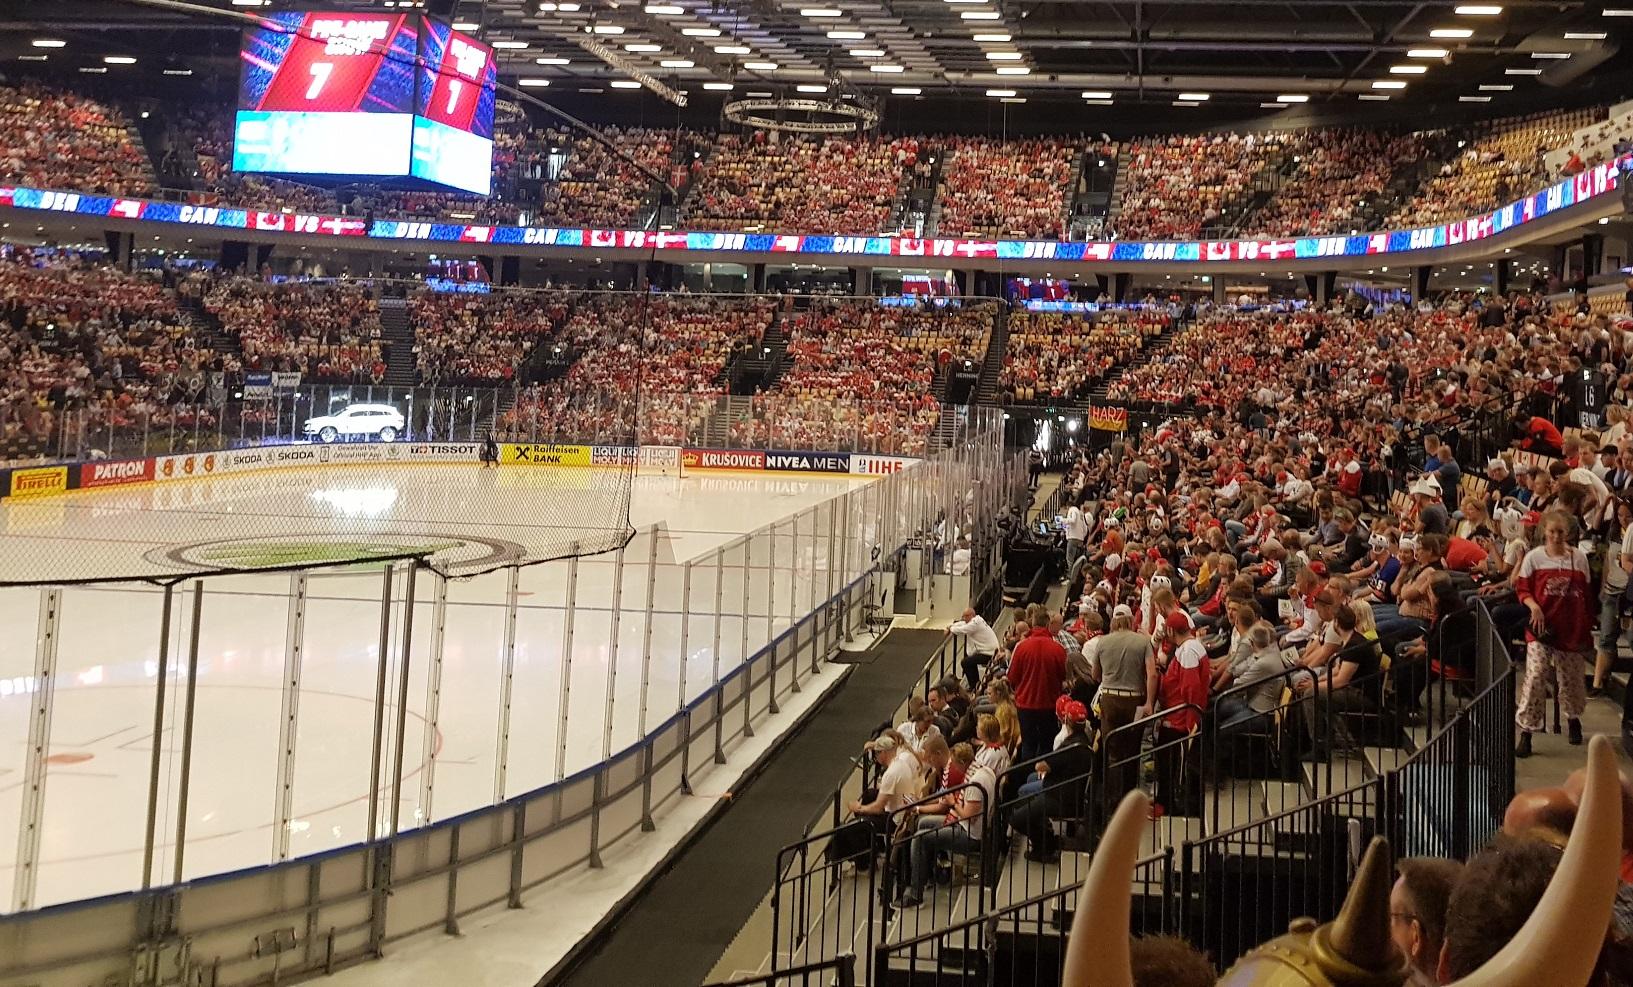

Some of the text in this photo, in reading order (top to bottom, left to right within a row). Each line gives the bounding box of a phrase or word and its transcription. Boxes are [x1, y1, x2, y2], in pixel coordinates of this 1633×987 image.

[179, 207, 320, 234] CAN VS
[524, 228, 646, 248] CAN VS
[833, 237, 954, 256] CAN VS
[1143, 240, 1258, 259] CAN VS
[1092, 405, 1125, 424] HARZ
[429, 445, 475, 454] TISSOT
[533, 444, 580, 455] Raiffeisen
[593, 447, 619, 457] LIQUI
[533, 455, 566, 463] BANK
[593, 456, 617, 464] MOLY
[702, 451, 762, 468] KRUŠOVICE
[766, 455, 850, 471] NIVEA MEN
[869, 459, 902, 473] IIHF
[93, 460, 146, 481] PATRON
